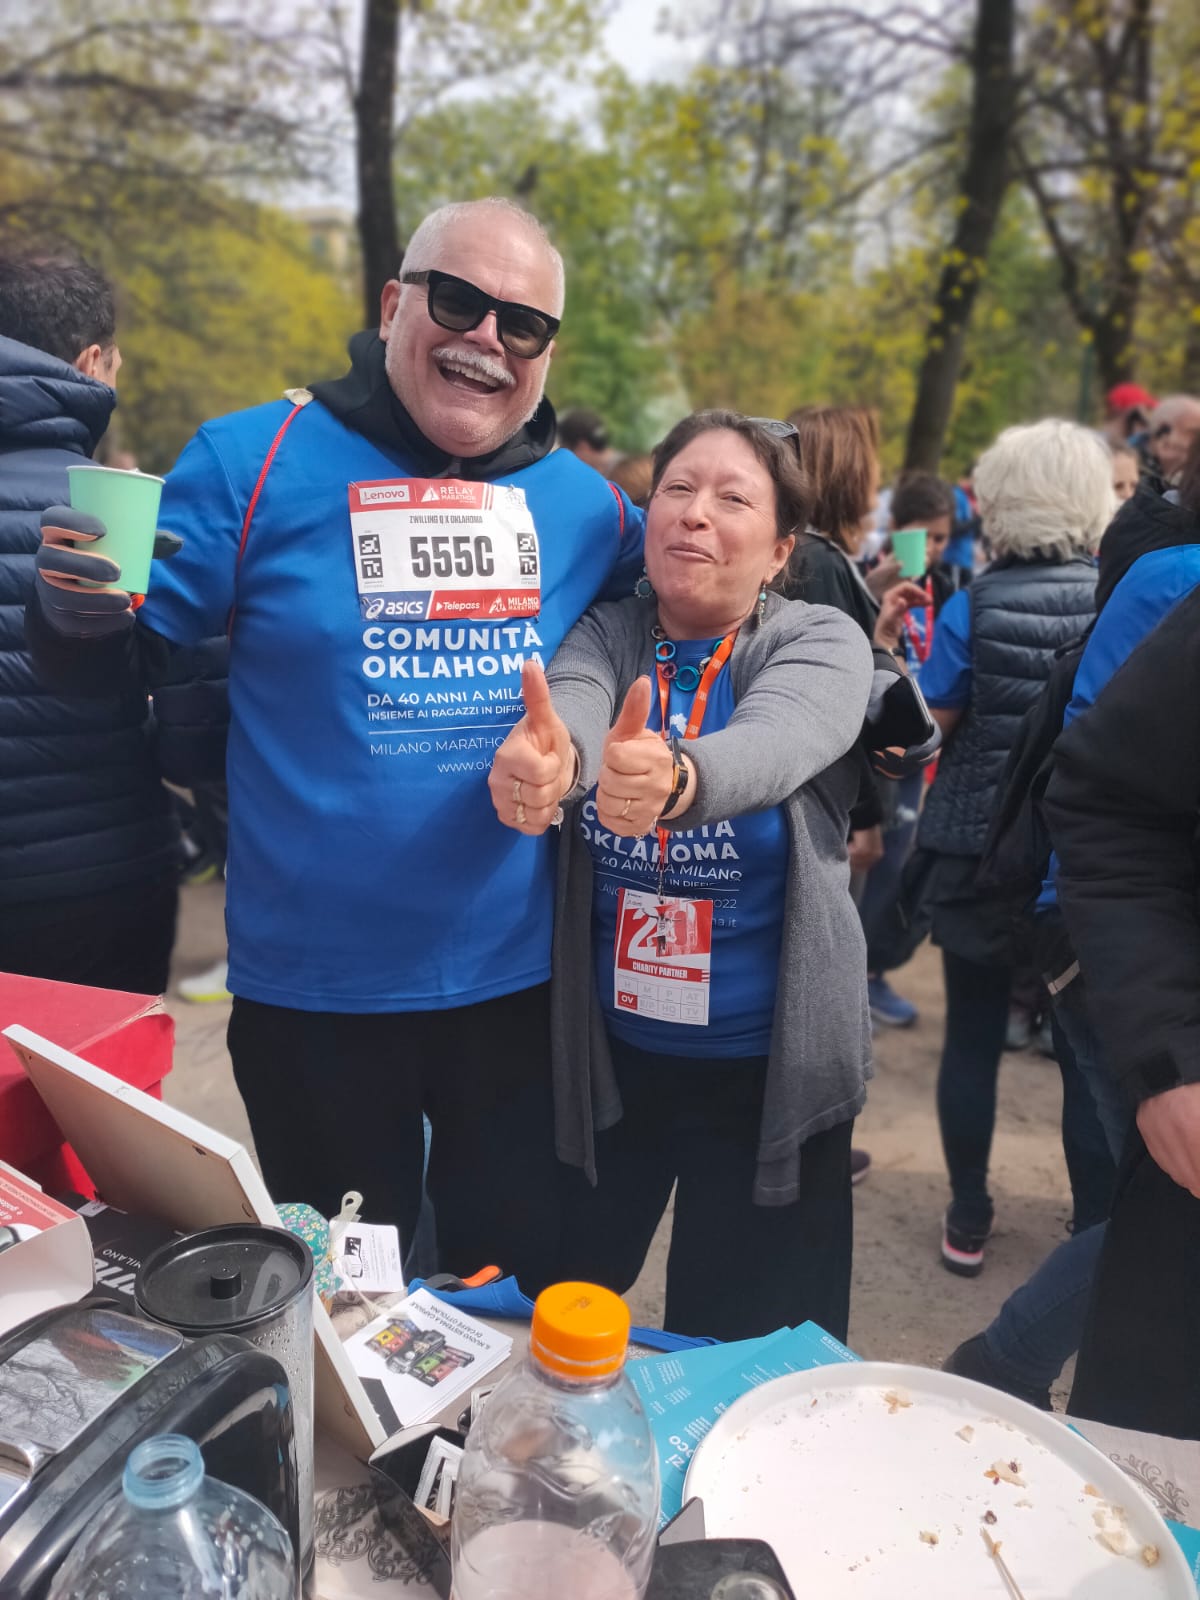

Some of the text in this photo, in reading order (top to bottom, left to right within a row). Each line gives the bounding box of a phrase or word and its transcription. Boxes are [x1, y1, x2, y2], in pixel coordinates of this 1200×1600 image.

[363, 489, 405, 501] Lenovo
[440, 486, 475, 495] RELAY
[409, 535, 495, 578] 555C
[384, 601, 424, 616] asics
[443, 601, 480, 612] Telepass
[507, 596, 539, 606] MILANO
[362, 622, 543, 650] COMUNITÀ
[367, 687, 525, 708] DA 40 ANNI A MILA
[368, 704, 528, 721] INSIEME AI RAGAZZI IN DIFFIC
[370, 736, 505, 756] MILANO MARATHO
[679, 864, 742, 881] MILANO
[632, 961, 688, 979] CHARITY PARTNER
